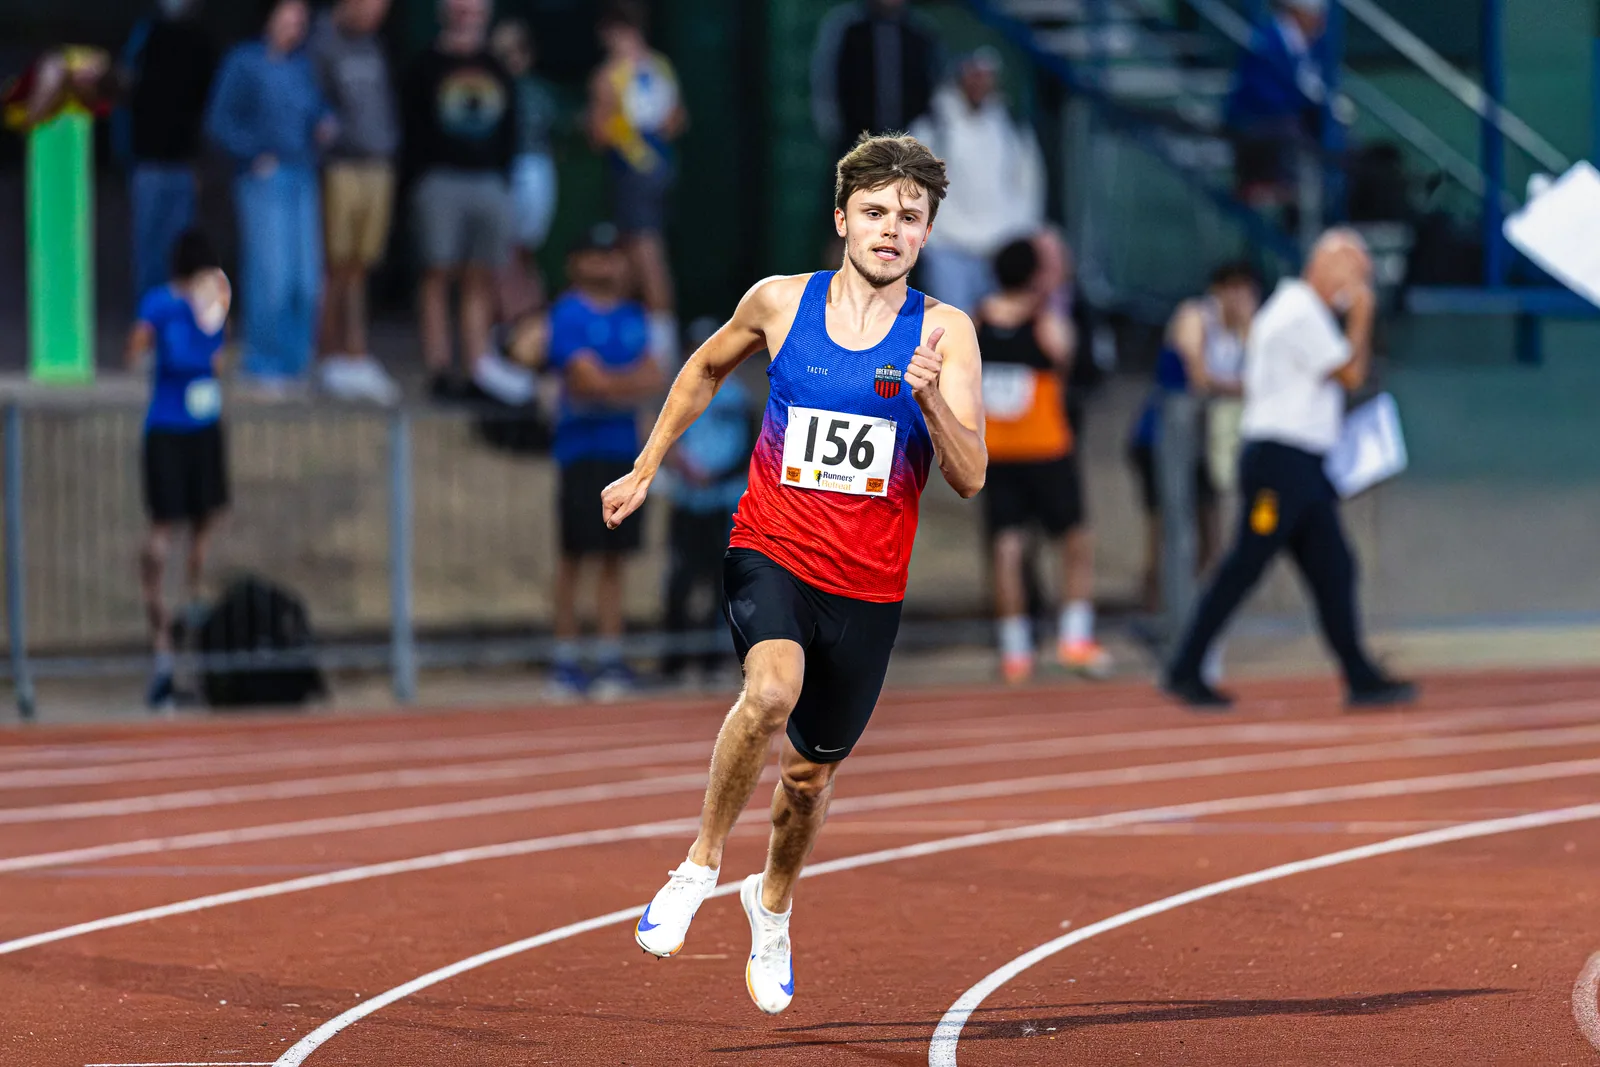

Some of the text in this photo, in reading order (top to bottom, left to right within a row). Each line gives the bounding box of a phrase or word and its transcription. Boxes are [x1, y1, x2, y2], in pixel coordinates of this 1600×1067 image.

[807, 365, 829, 376] TACTIC
[804, 416, 875, 470] 156
[823, 471, 855, 482] Runners'
[821, 480, 852, 491] Retreat
